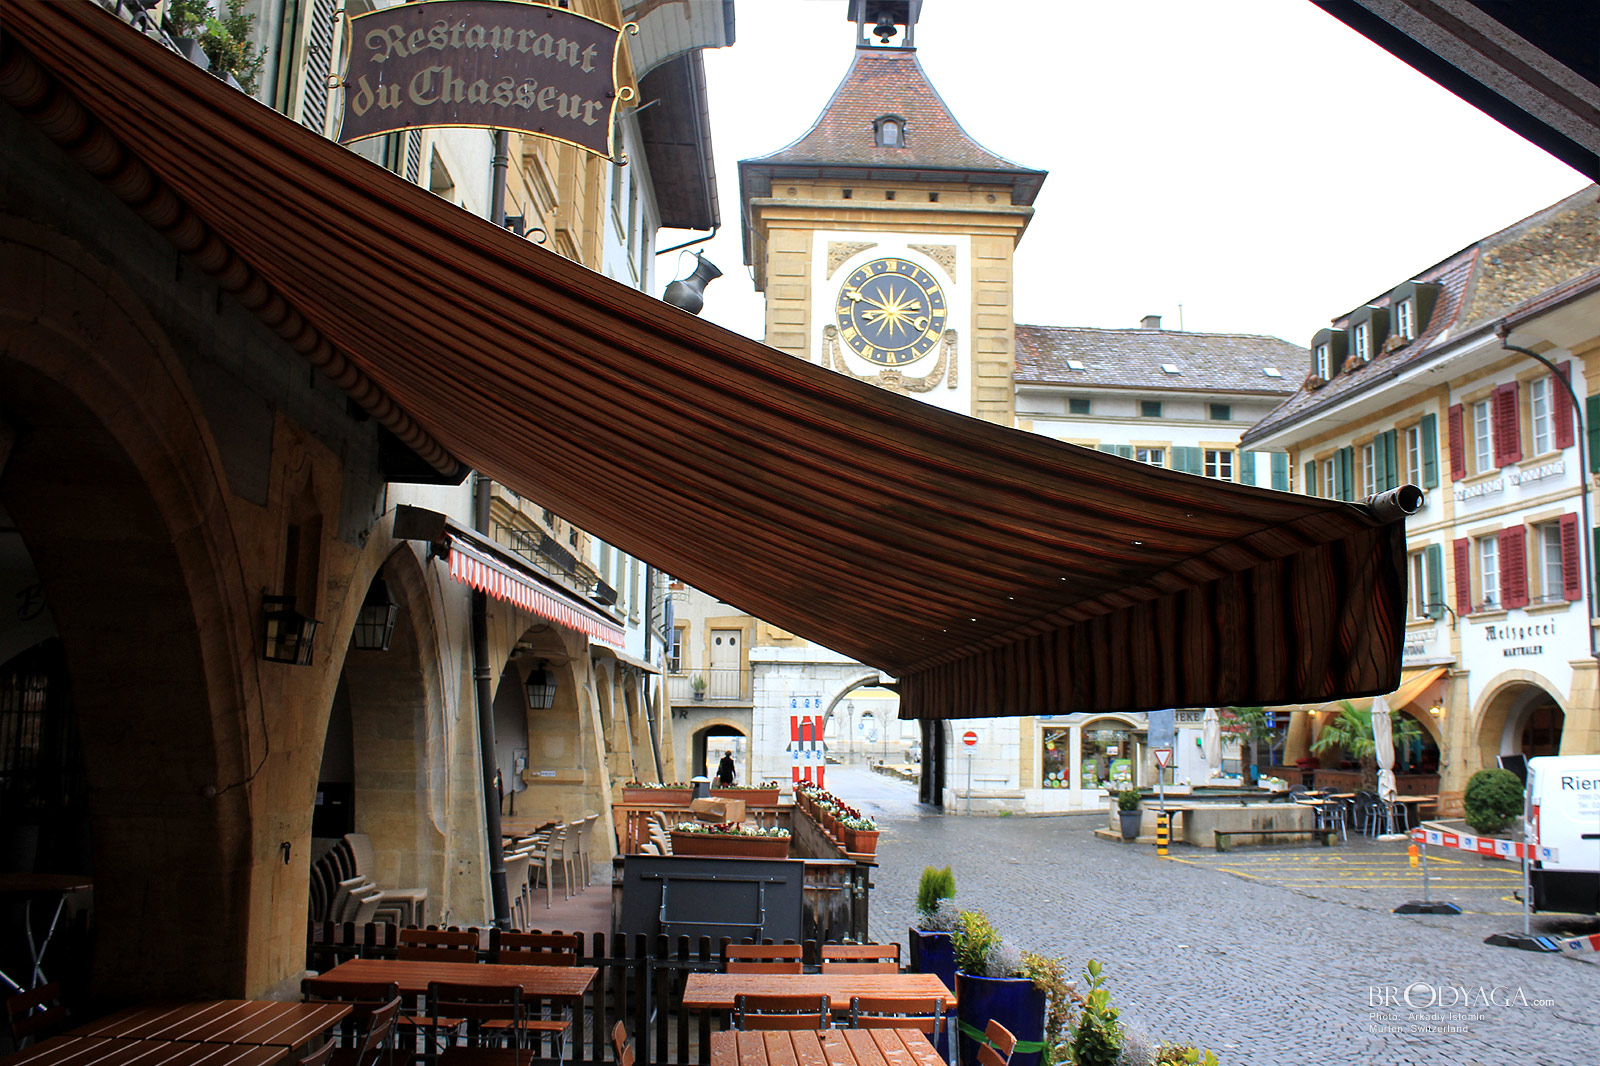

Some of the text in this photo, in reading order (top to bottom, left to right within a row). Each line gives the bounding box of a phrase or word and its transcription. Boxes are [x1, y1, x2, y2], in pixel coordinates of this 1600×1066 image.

[364, 19, 598, 74] Restaurant
[352, 65, 603, 126] du Chasseur
